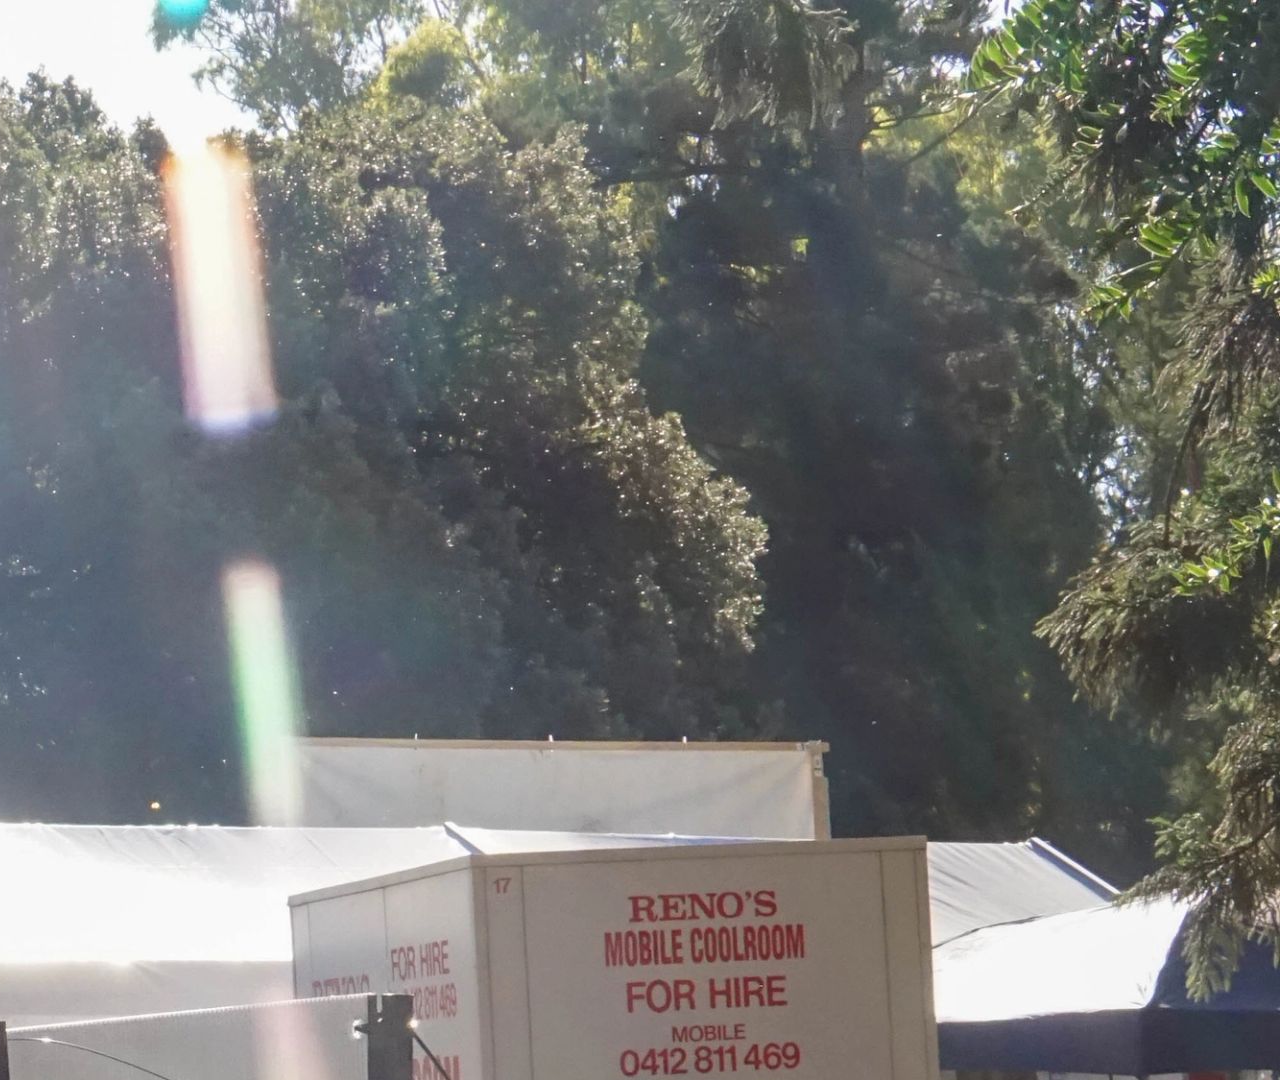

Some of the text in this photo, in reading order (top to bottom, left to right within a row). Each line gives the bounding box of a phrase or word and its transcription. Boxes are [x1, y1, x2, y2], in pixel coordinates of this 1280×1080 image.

[493, 877, 512, 895] 17
[627, 889, 778, 923] RENO'S
[390, 939, 450, 983] FOR HIRE
[603, 923, 806, 967] MOBILE COOLROOM
[625, 975, 789, 1014] FOR HIRE
[671, 1023, 747, 1044] MOBILE
[619, 1041, 802, 1078] 0412 811 469
